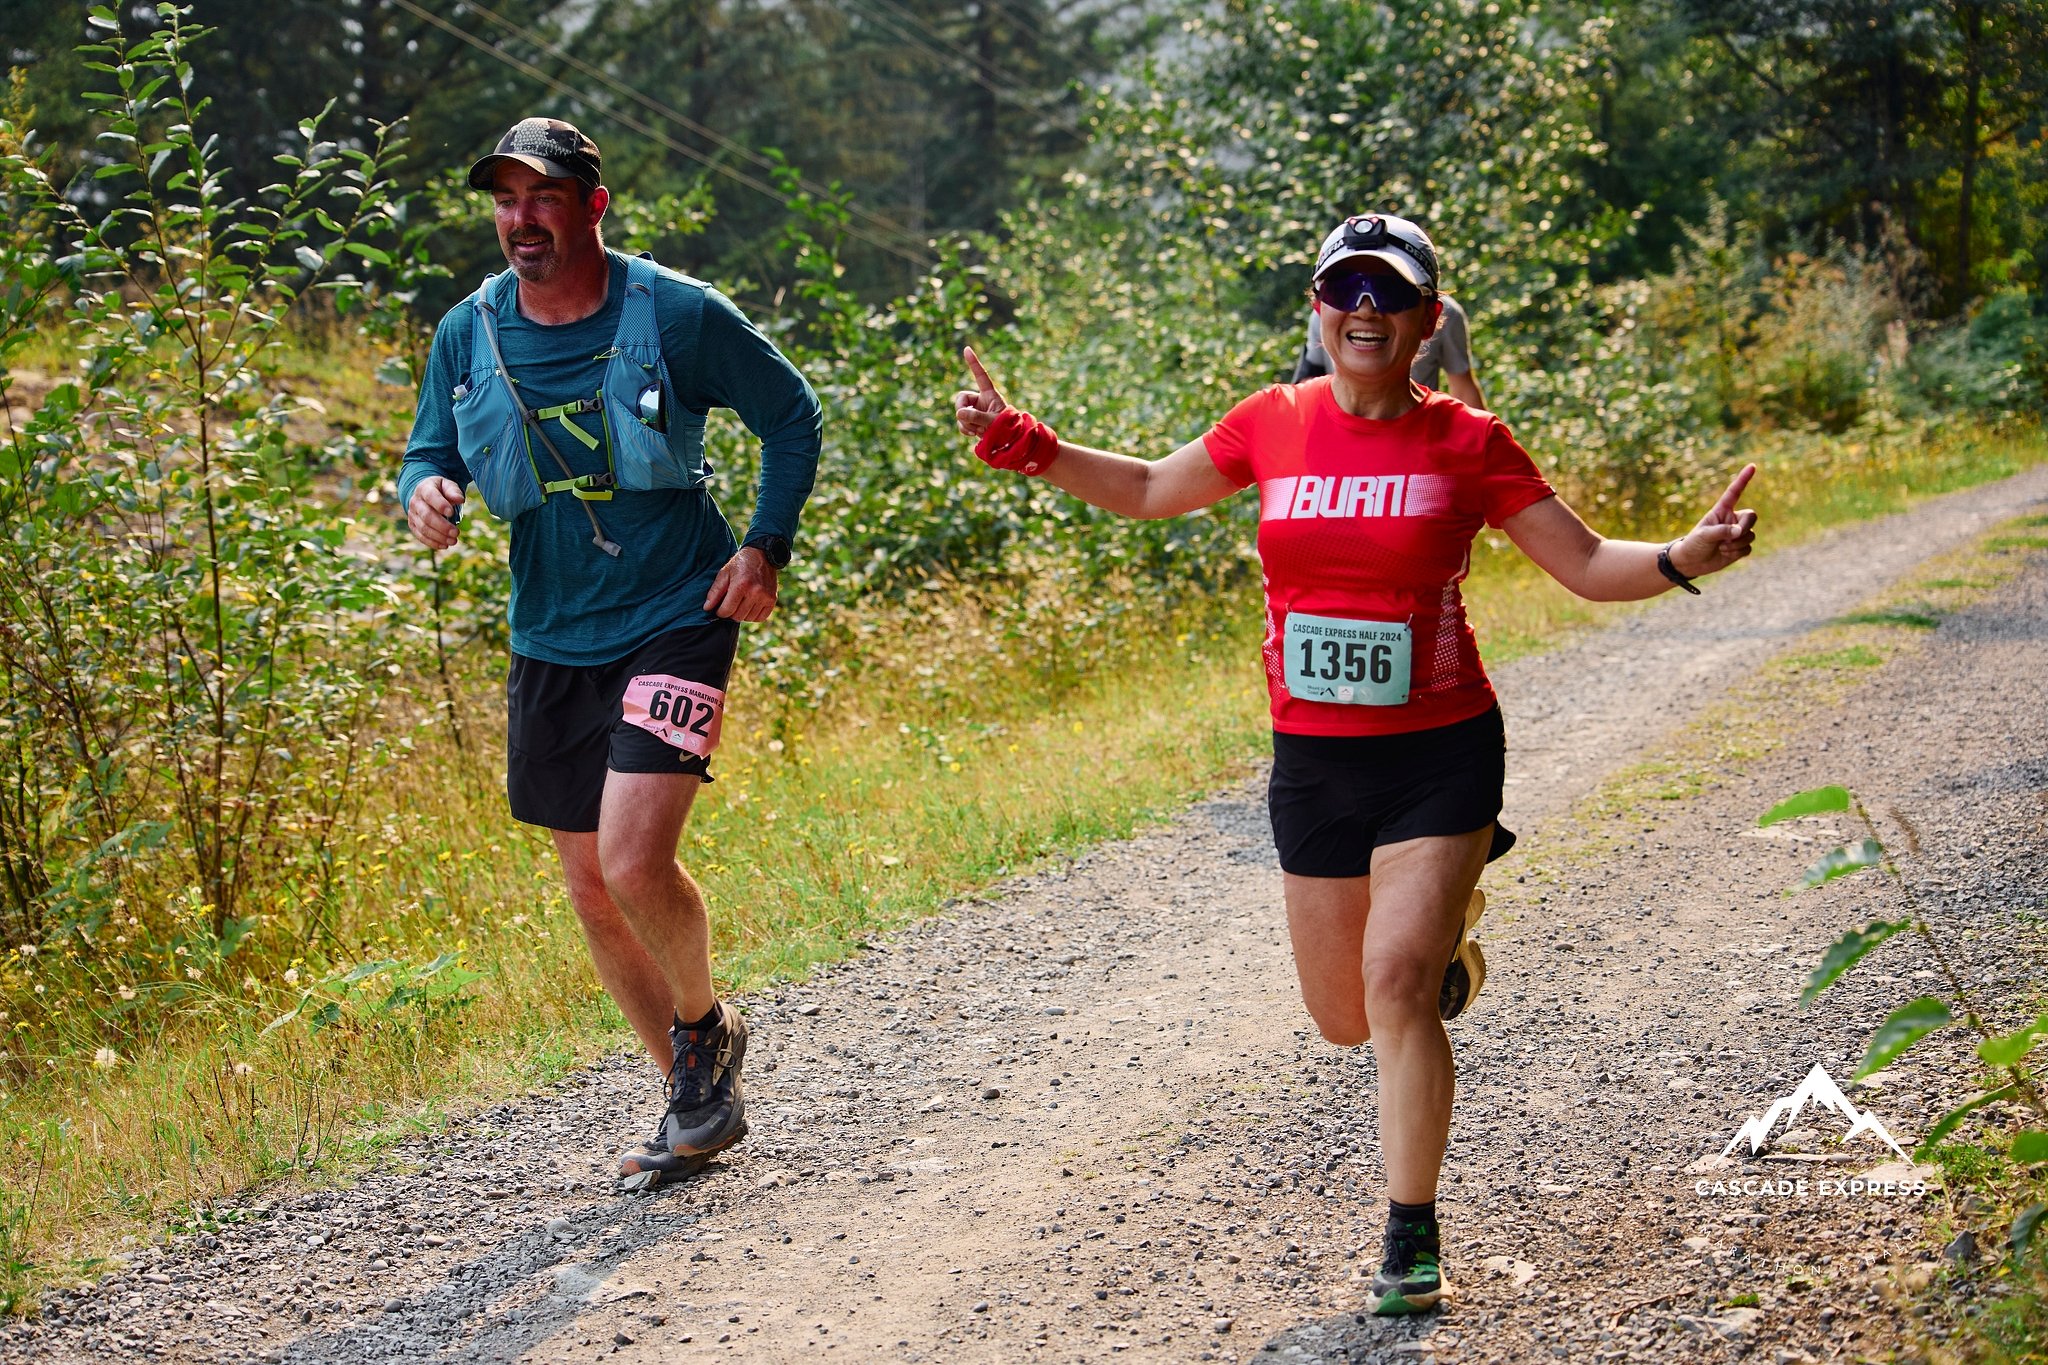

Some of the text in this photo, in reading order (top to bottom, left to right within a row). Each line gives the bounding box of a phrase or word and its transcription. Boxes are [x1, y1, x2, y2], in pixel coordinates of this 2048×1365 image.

[1290, 474, 1406, 519] BURN
[1293, 624, 1402, 642] CASCADE EXPRESS HALF 2024
[1300, 638, 1392, 684] 1356
[638, 680, 663, 688] CASCADE
[664, 683, 688, 693] EXPRESS
[689, 689, 718, 706] MARATHON
[649, 689, 715, 738] 602
